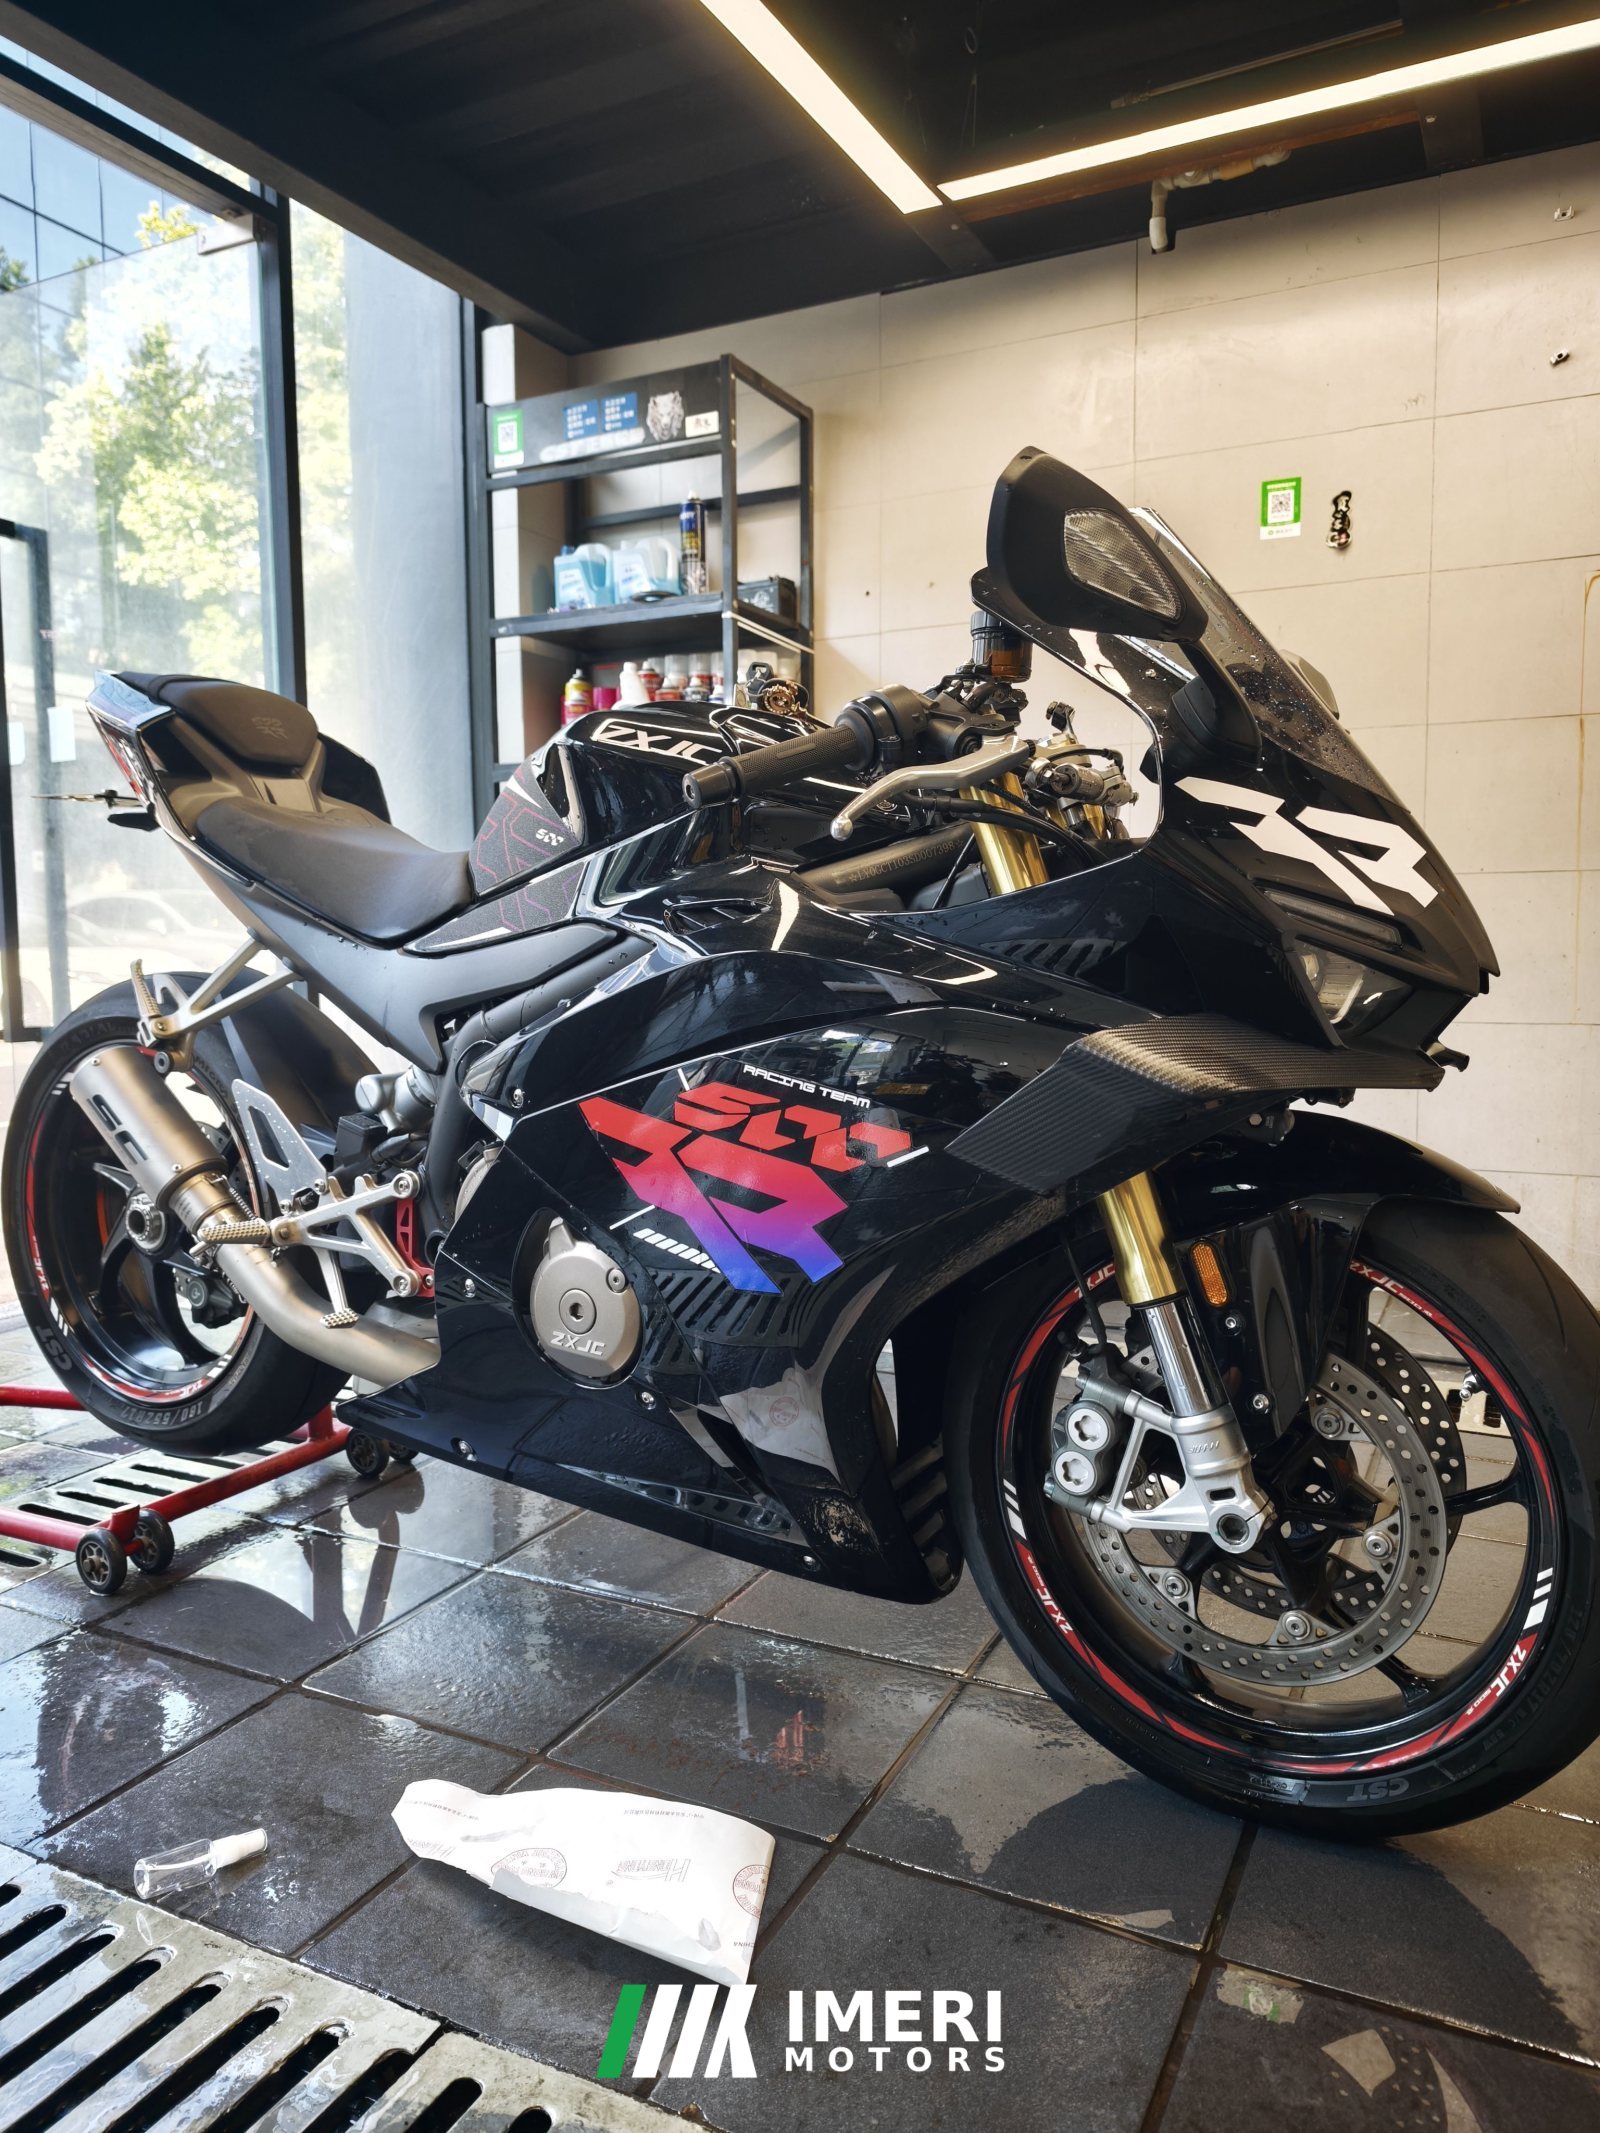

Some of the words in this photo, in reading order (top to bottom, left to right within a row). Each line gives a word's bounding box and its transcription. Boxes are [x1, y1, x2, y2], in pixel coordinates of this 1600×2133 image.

[536, 828, 565, 845] 500
[743, 1064, 815, 1094] RACING
[818, 1088, 872, 1109] TEAM
[35, 1325, 72, 1371] CST
[550, 1330, 607, 1356] ZXJC
[1036, 1587, 1074, 1634] ZXJC
[1490, 1644, 1527, 1697] ZXJC
[1346, 1777, 1410, 1801] CST
